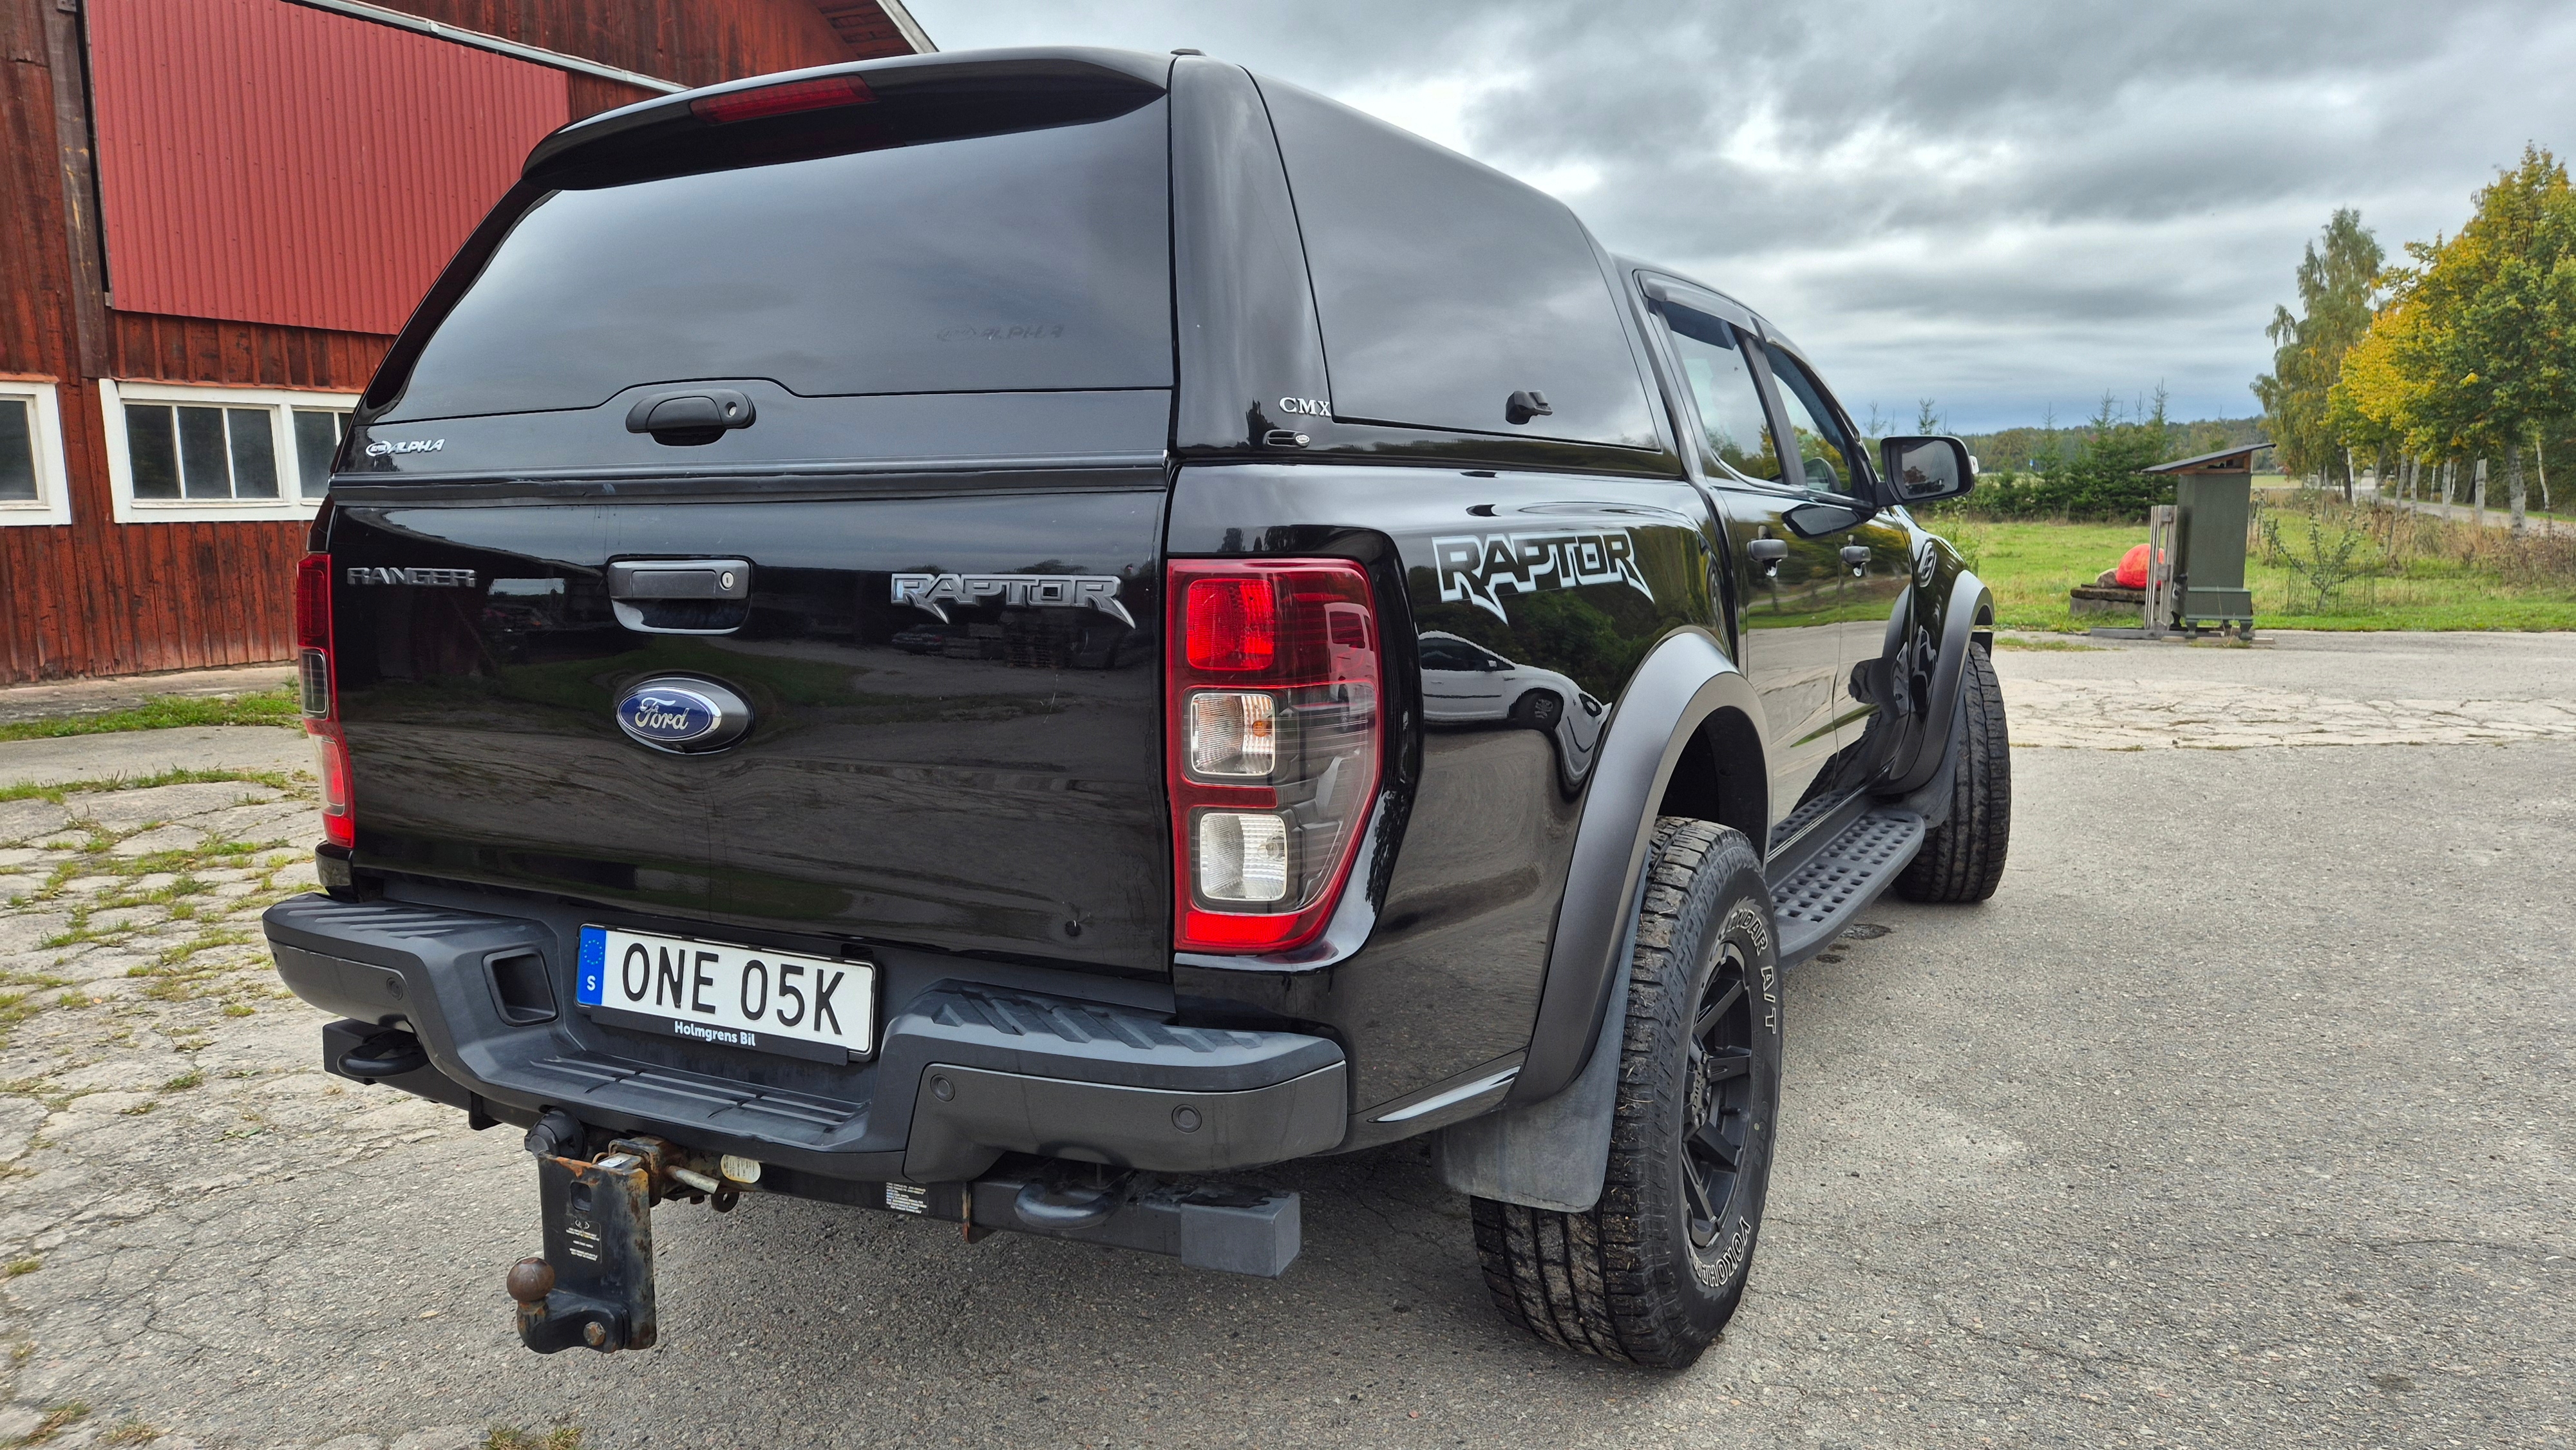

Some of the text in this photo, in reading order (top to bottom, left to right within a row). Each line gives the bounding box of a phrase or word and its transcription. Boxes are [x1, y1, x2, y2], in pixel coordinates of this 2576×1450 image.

[1279, 397, 1332, 418] CMX
[387, 438, 446, 455] ALPHA
[347, 567, 475, 587] RANGER
[1431, 529, 1655, 626] RAPTOR
[891, 572, 1137, 629] RAPTOR
[634, 697, 689, 730] Ford
[586, 975, 596, 992] S
[622, 942, 719, 1015] ONE
[674, 1021, 756, 1047] Holmgrens Bil
